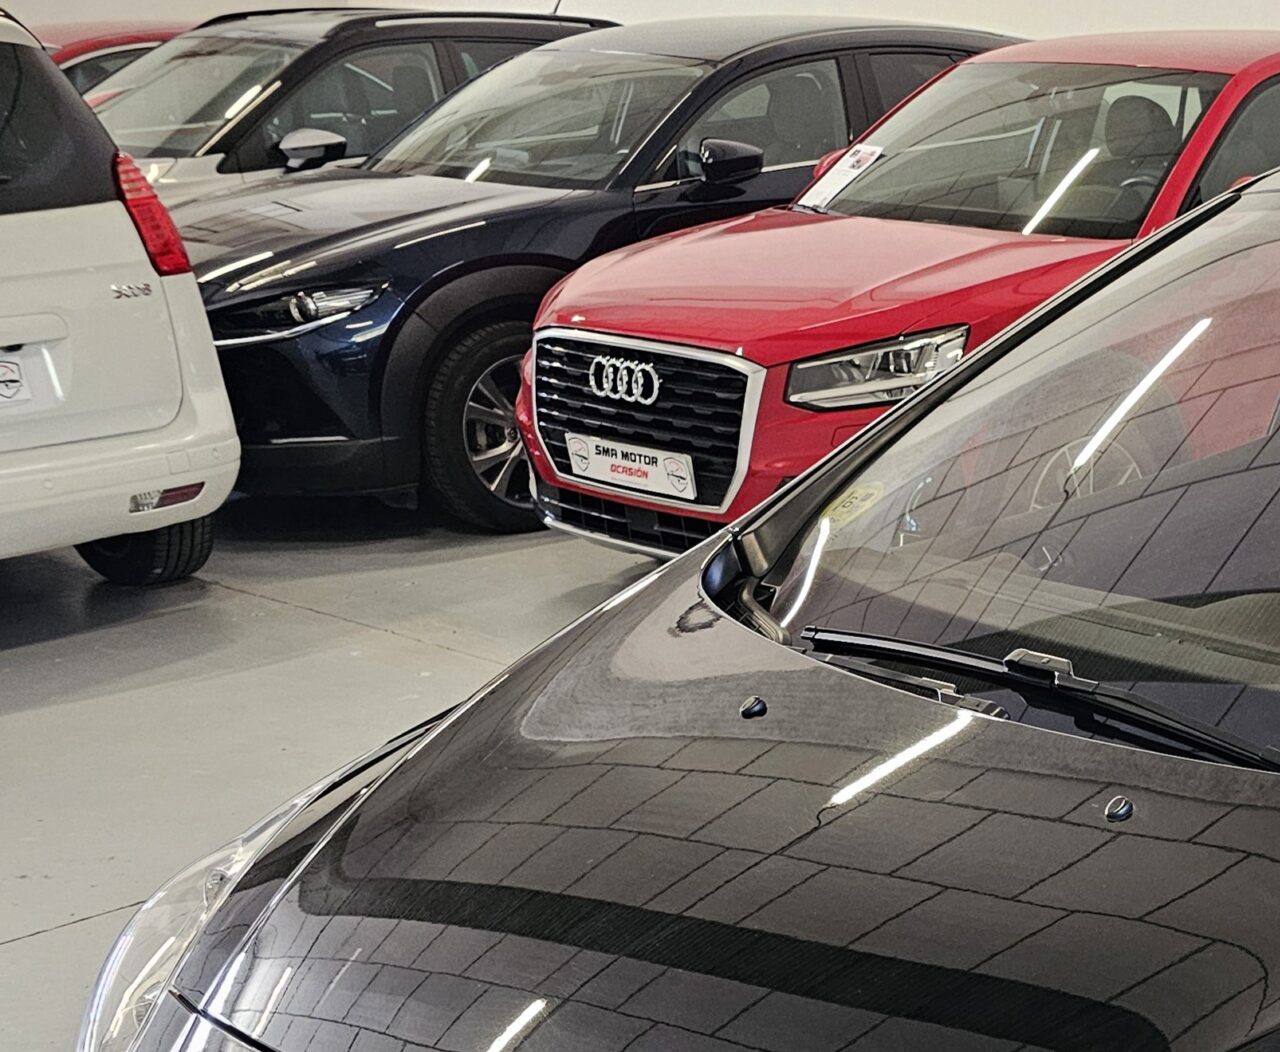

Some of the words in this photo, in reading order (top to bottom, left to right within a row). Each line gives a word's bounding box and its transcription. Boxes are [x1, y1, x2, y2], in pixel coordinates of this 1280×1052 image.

[595, 445, 618, 459] SMA
[621, 451, 658, 467] MOTOR
[610, 463, 649, 479] OCASIÓN
